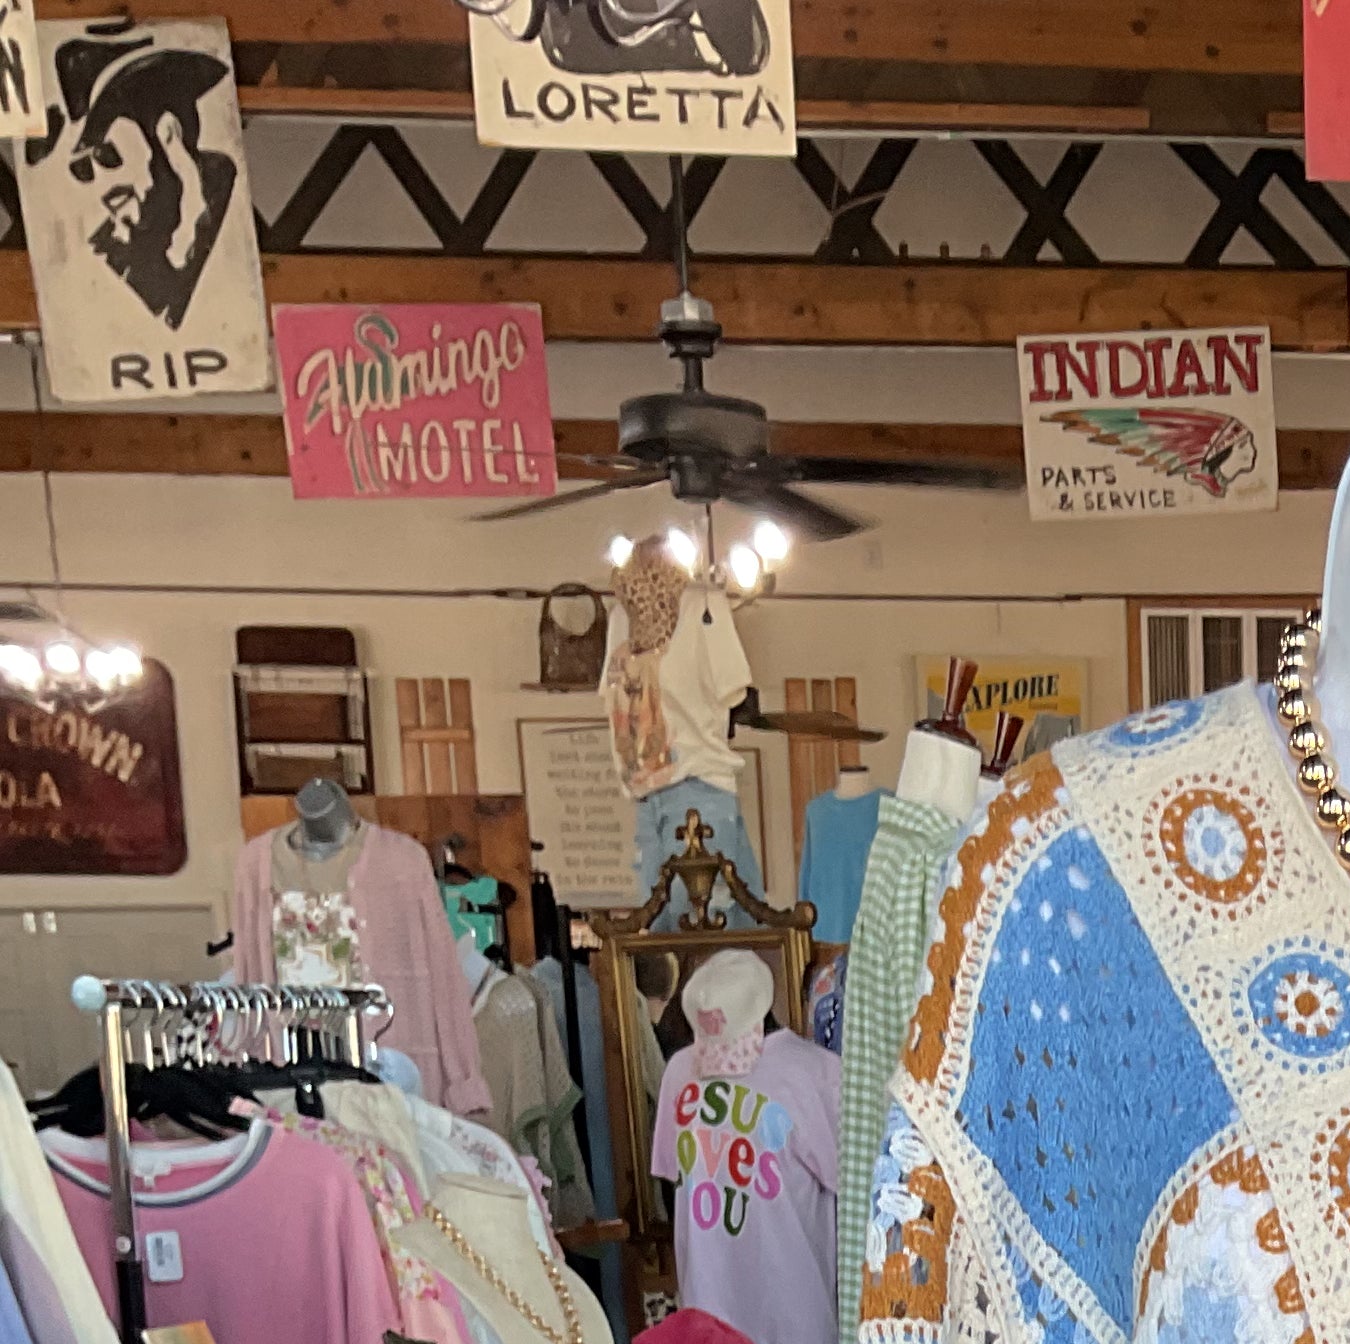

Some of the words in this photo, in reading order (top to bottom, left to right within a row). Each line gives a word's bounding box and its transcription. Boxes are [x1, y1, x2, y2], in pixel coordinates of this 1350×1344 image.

[503, 81, 785, 132] LORETTA
[112, 351, 228, 389] RIP
[298, 321, 526, 434] Flamingo
[1024, 334, 1263, 402] INDIAN
[377, 419, 540, 483] MOTEL
[1041, 465, 1117, 487] PARTS
[1058, 492, 1073, 511] &
[1084, 488, 1177, 511] SERVICE
[965, 673, 1059, 713] XPLORE
[688, 1181, 750, 1236] OU
